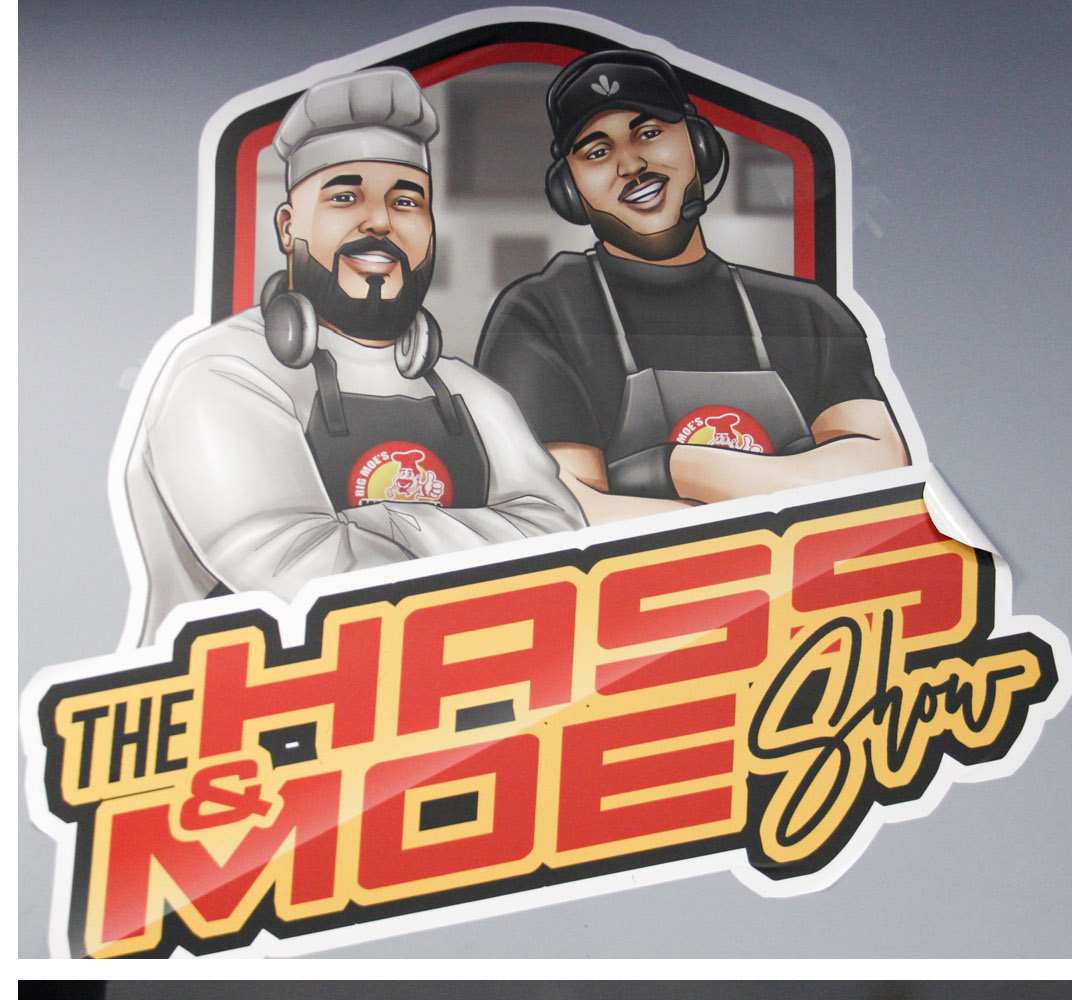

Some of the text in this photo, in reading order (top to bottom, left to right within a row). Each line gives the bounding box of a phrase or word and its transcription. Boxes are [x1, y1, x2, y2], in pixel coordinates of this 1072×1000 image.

[355, 451, 390, 497] BIG MOE'S
[71, 512, 963, 789] THE HASS
[101, 609, 1026, 943] & MOE Show
